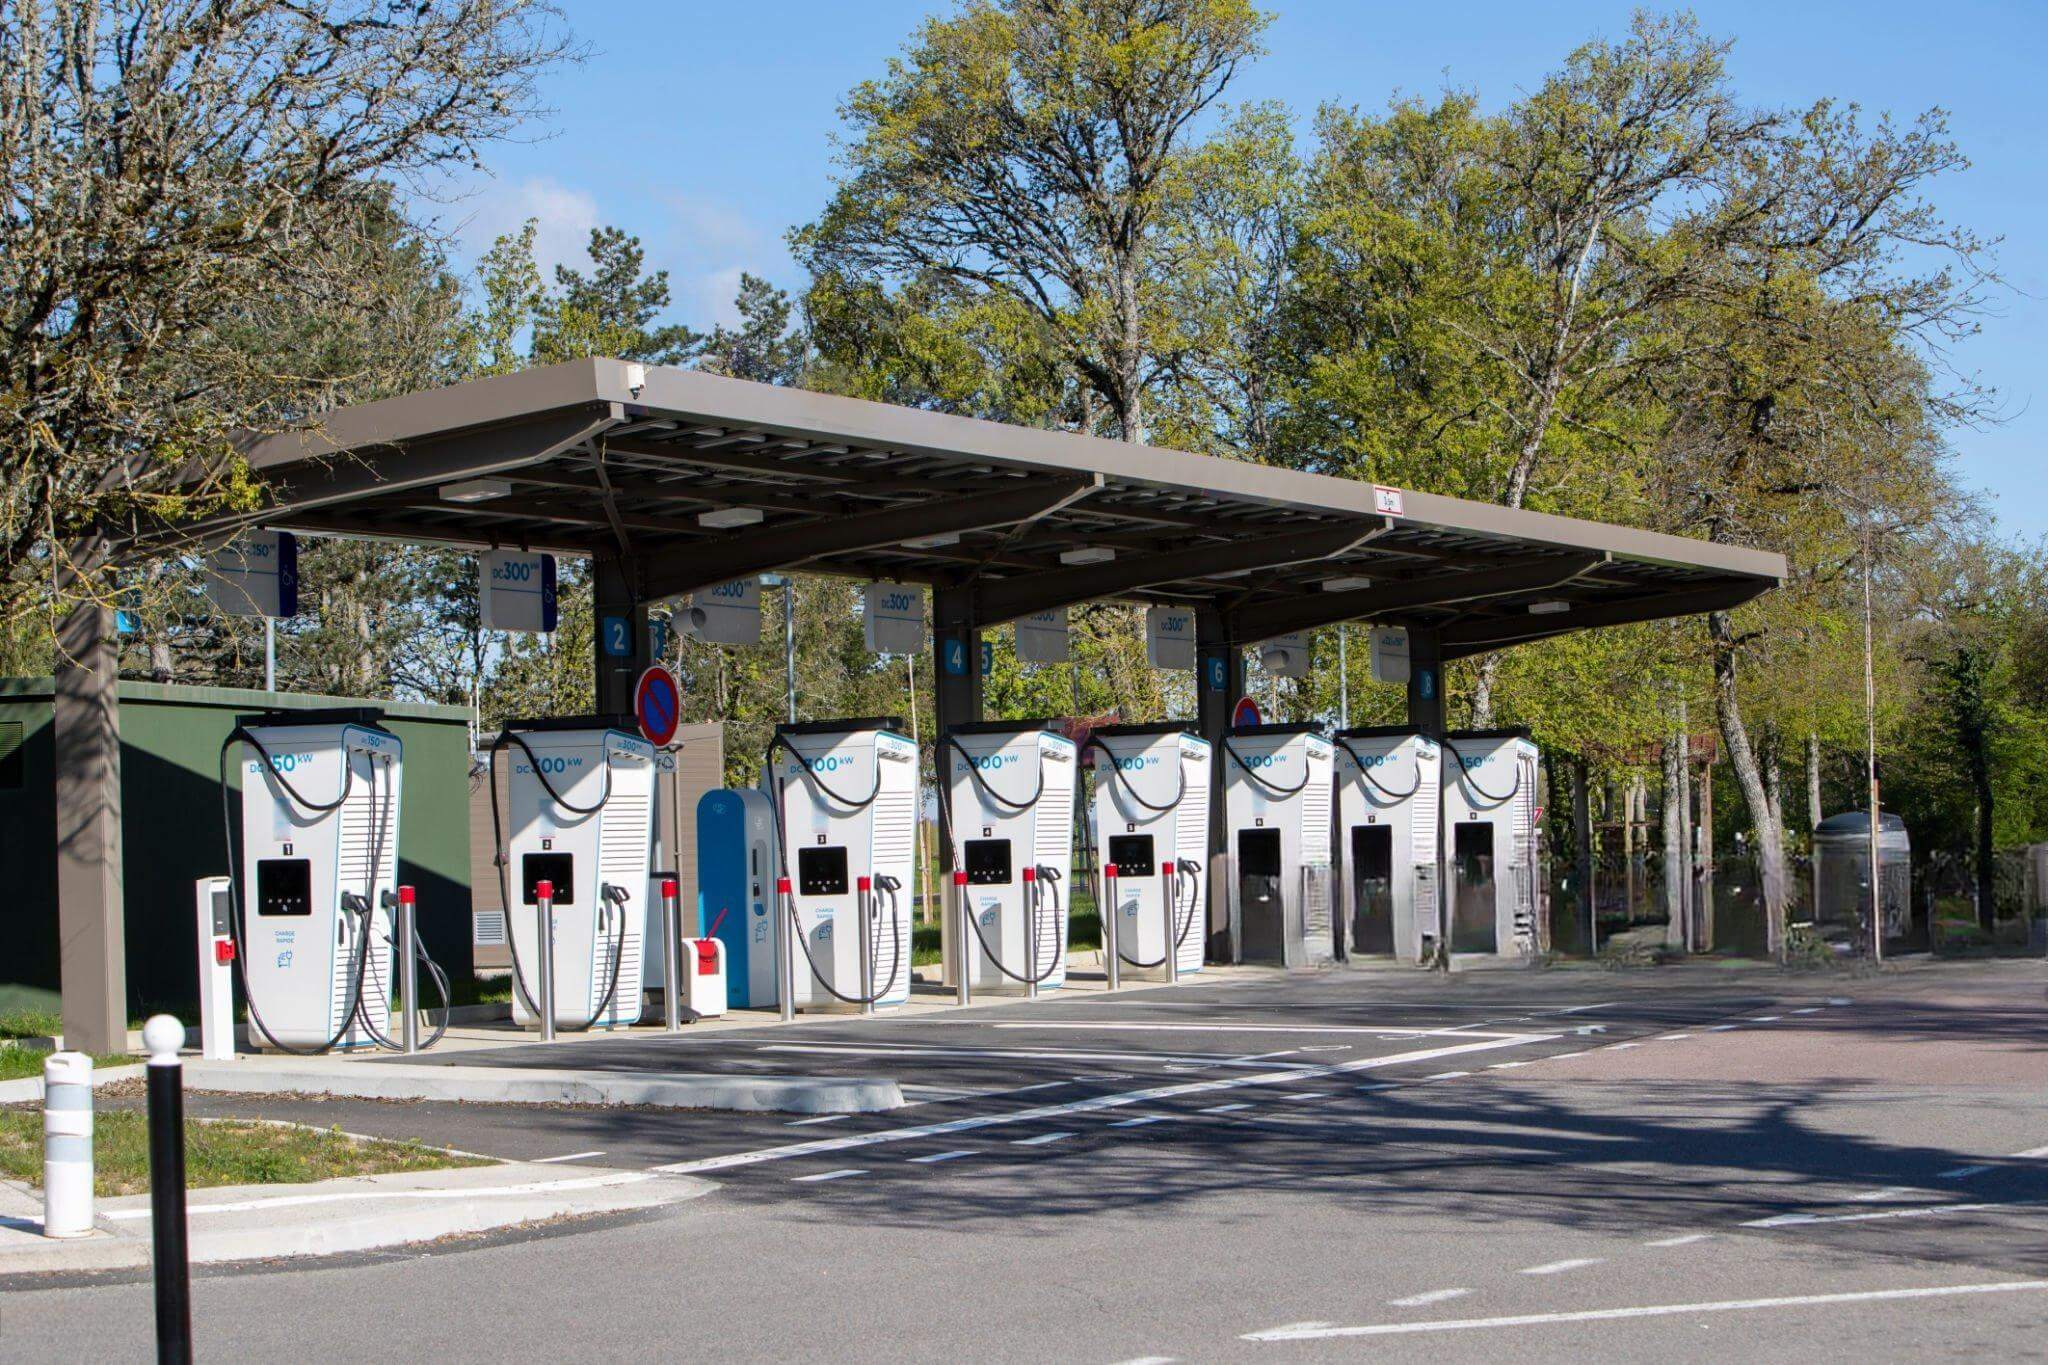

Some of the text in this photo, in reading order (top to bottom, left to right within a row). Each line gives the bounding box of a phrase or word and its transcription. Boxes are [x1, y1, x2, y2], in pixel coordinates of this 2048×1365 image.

[503, 562, 530, 581] 300
[889, 593, 909, 611] 300
[1168, 617, 1183, 632] 300
[613, 623, 625, 650] 2
[951, 645, 961, 669] 4
[1214, 661, 1223, 683] 6
[1425, 674, 1432, 694] 8
[367, 735, 380, 748] 150
[623, 740, 636, 751] 300
[298, 754, 313, 763] kW
[516, 765, 529, 774] DC
[567, 758, 583, 767] kW
[790, 765, 803, 774] DC
[839, 756, 854, 764] kW
[957, 763, 970, 771] DC
[972, 755, 1002, 769] 300
[1244, 755, 1272, 767] 300
